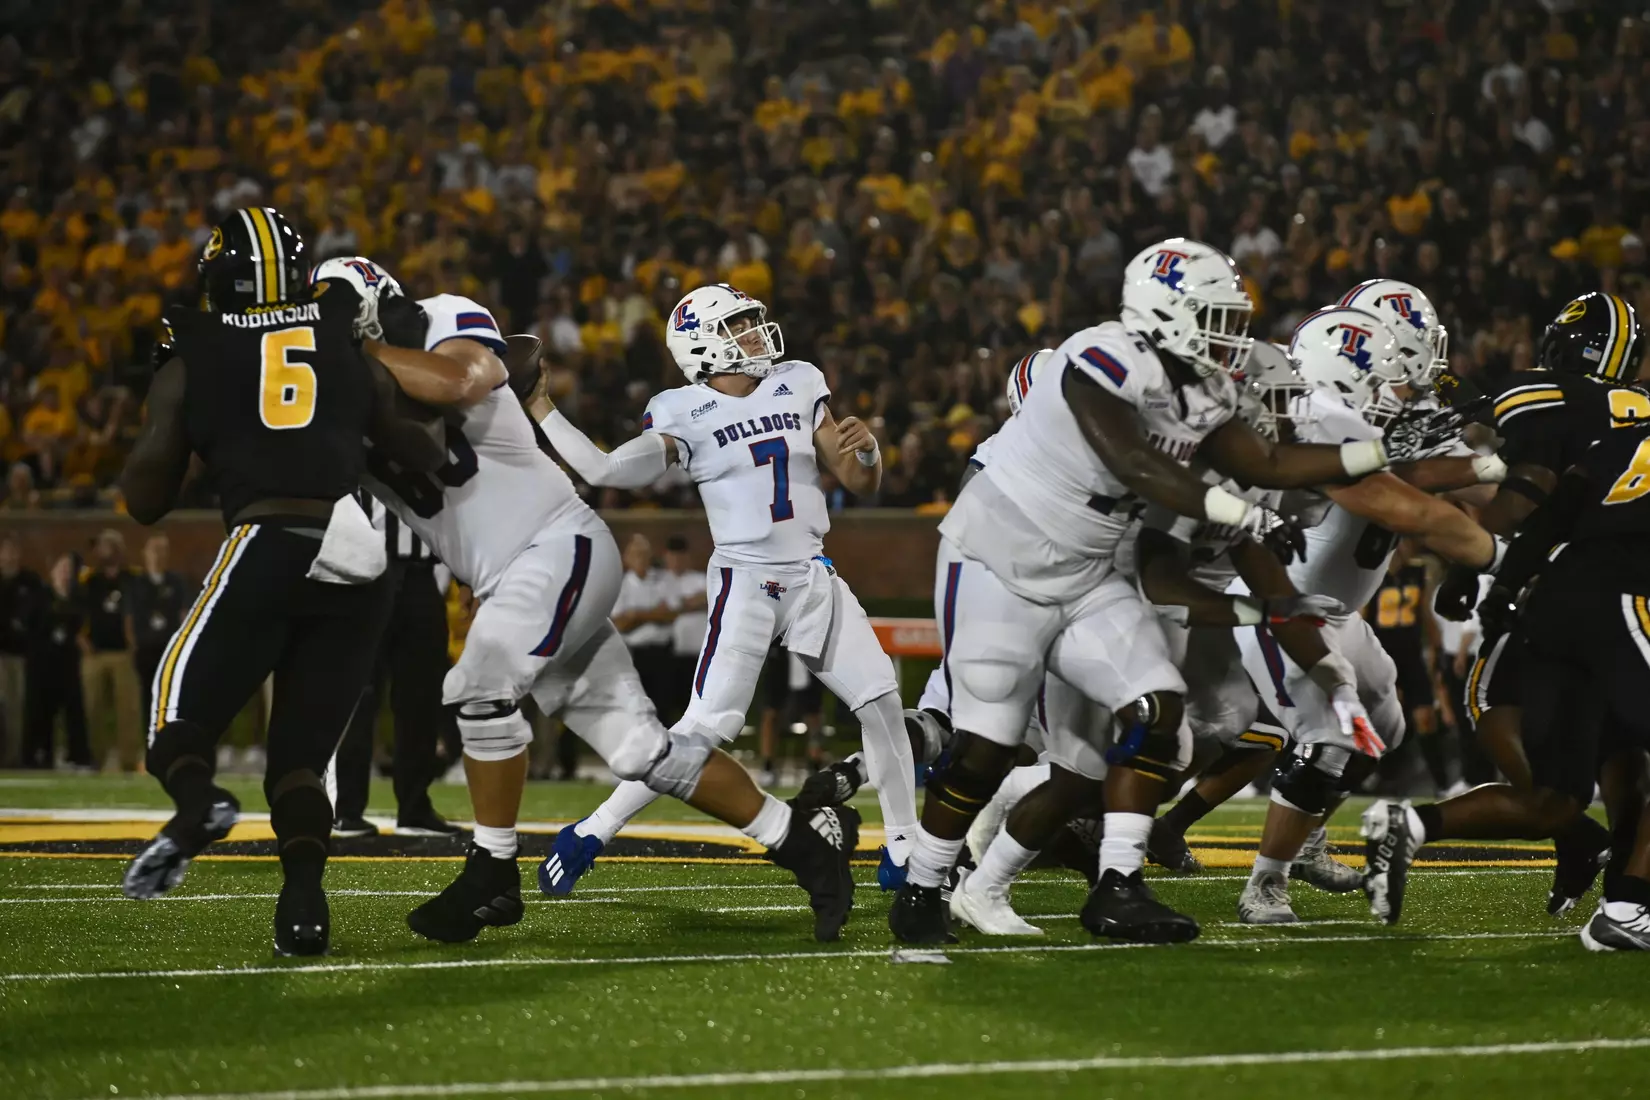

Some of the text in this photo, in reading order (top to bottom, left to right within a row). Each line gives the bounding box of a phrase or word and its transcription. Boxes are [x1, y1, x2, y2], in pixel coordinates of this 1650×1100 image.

[222, 302, 320, 328] ROBINSON
[259, 326, 316, 430] 6
[713, 412, 801, 448] BULLDOGS
[748, 436, 794, 523] 7
